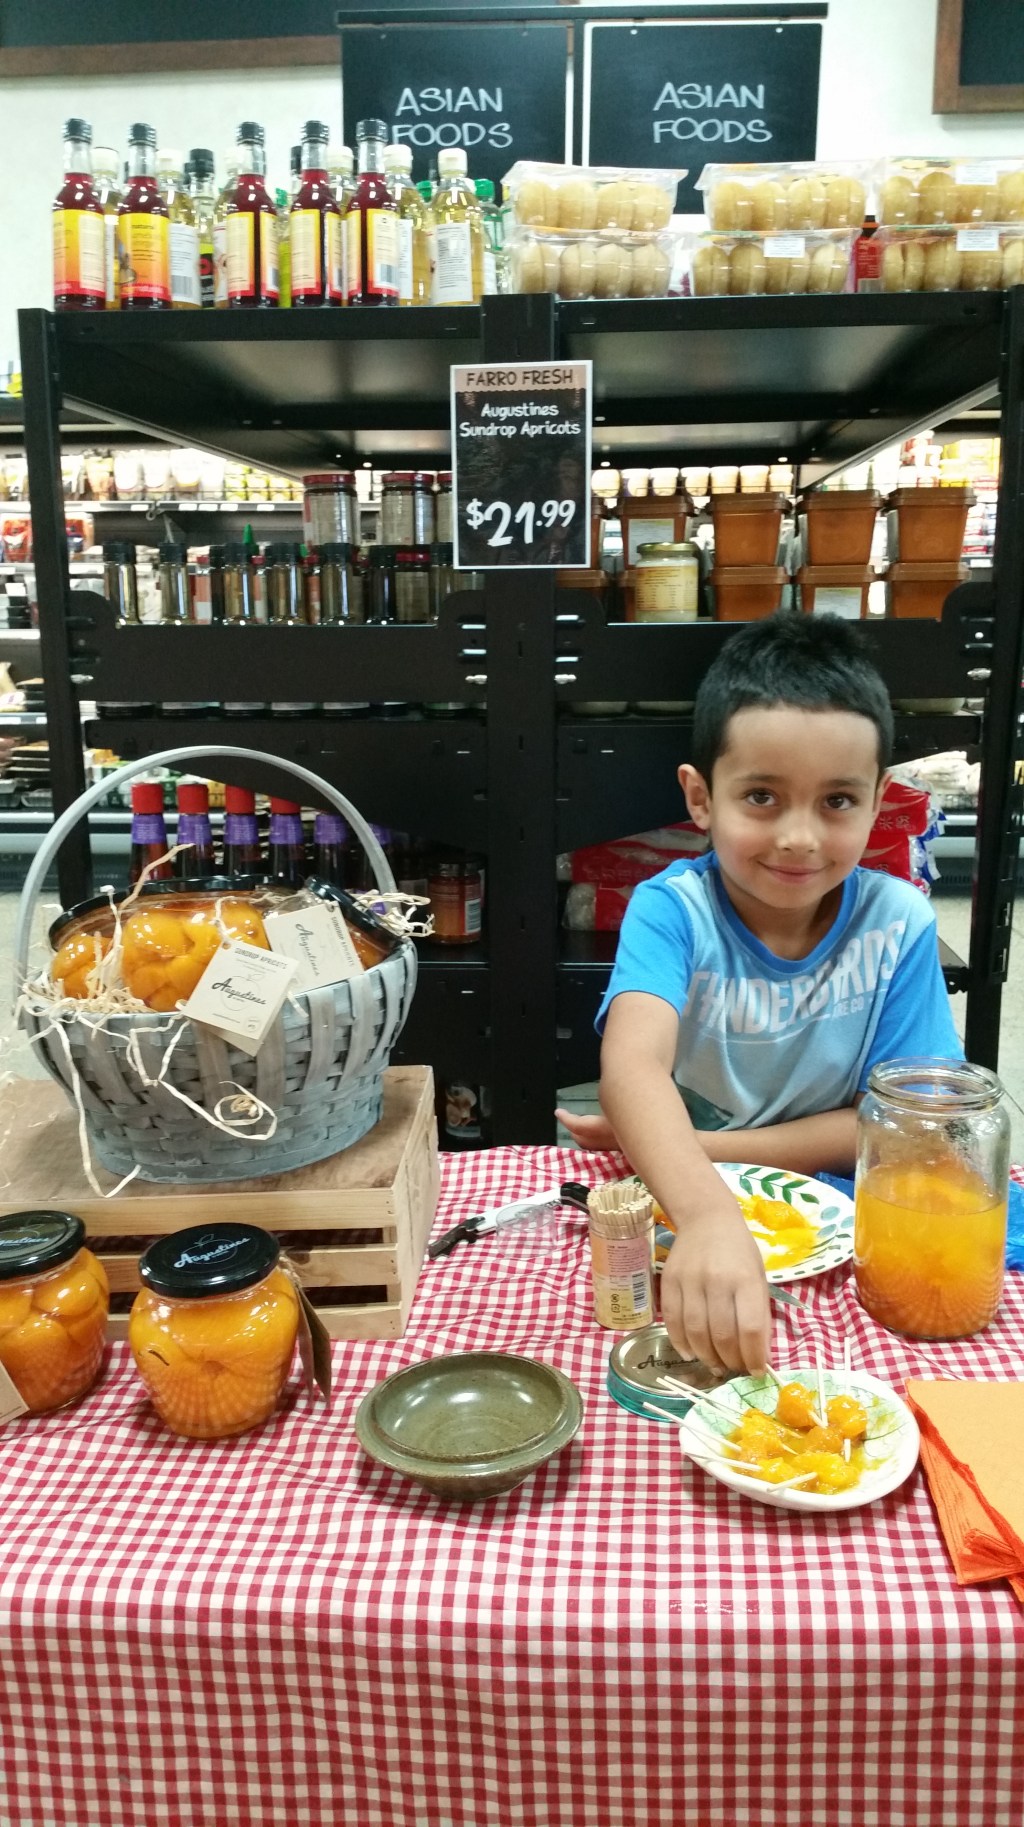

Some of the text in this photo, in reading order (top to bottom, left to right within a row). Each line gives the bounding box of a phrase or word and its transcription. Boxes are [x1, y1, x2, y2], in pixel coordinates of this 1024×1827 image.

[394, 86, 503, 117] ASIAN
[652, 81, 765, 112] ASIAN
[391, 122, 514, 149] FOODS
[652, 116, 774, 144] FOODS
[466, 368, 574, 387] FARRO FRESH
[480, 401, 560, 421] Augustines
[459, 420, 582, 439] Sundrop Apricots
[465, 497, 577, 548] $21.99
[211, 977, 267, 1005] Augustines
[173, 1237, 251, 1269] Augustines
